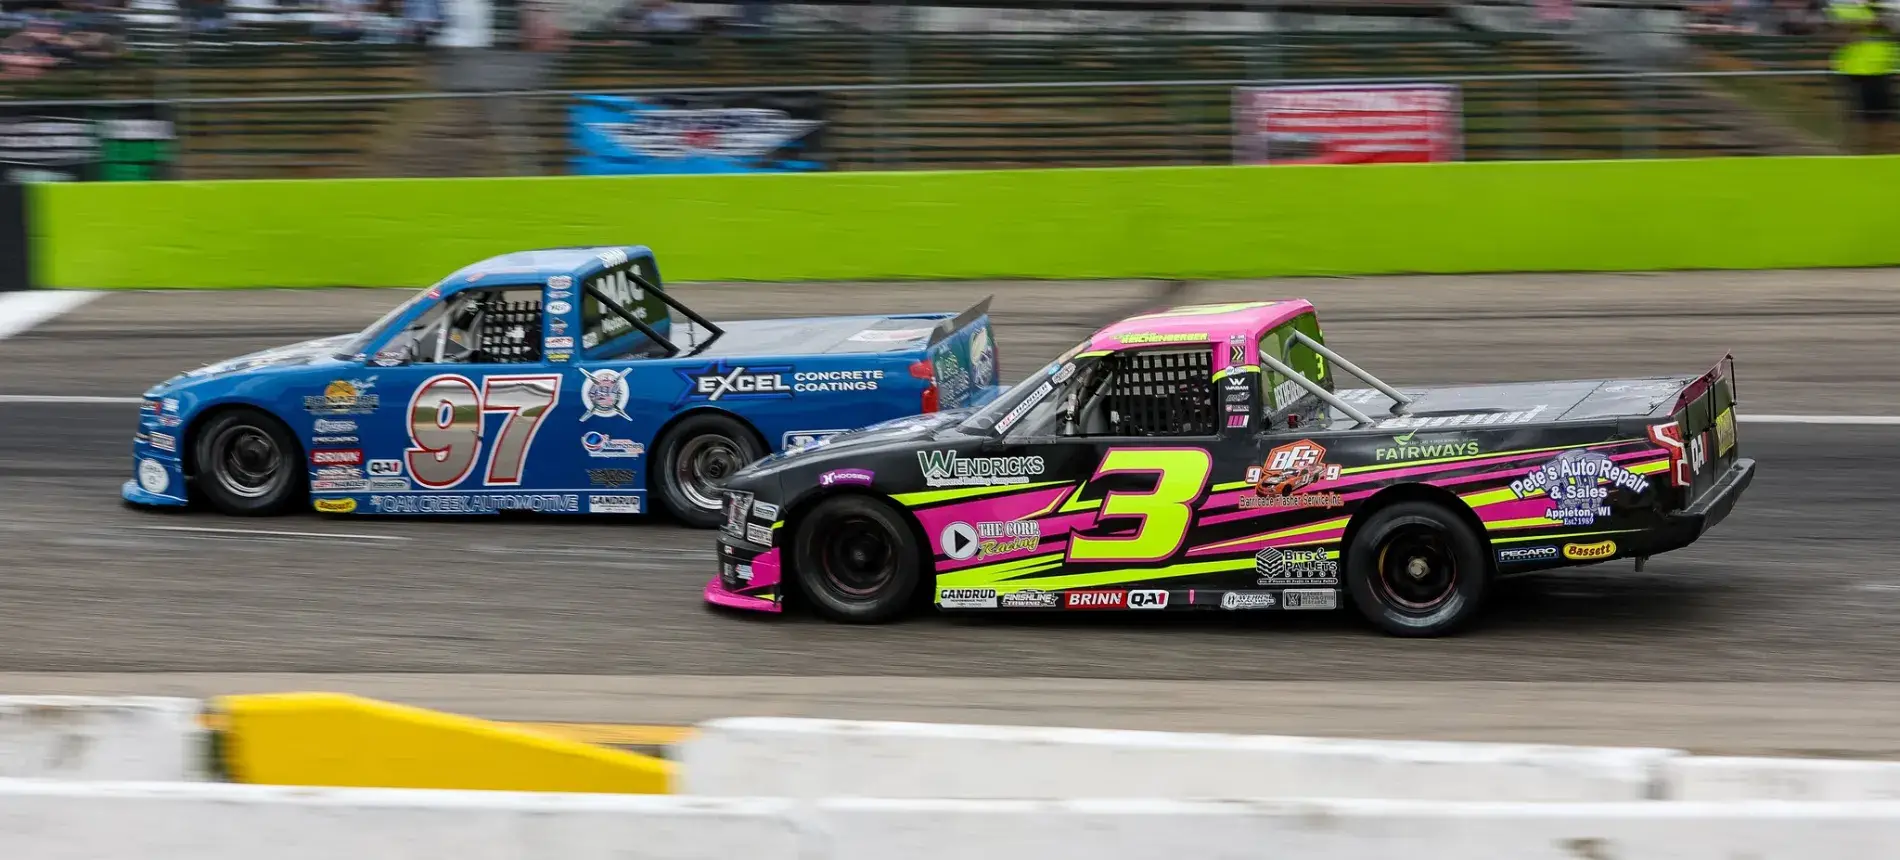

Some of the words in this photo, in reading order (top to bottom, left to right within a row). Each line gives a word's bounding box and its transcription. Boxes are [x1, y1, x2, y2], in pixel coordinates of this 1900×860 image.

[794, 370, 883, 381] CONCRETE
[698, 366, 790, 400] EXCEL
[794, 382, 878, 391] COATINGS
[404, 374, 563, 488] 97
[1376, 442, 1479, 460] FAIRWAYS
[371, 462, 398, 473] QA1
[917, 450, 1045, 478] WENDRICKS
[1510, 466, 1557, 499] Pete's
[1561, 457, 1596, 478] Auto
[1599, 459, 1649, 493] Repair
[1550, 486, 1562, 499] &
[1567, 486, 1607, 498] Sales
[420, 495, 470, 512] CREEK
[471, 494, 579, 512] AUTOMOTIVE
[1066, 447, 1212, 562] 3
[1546, 508, 1594, 519] Appleton,
[1598, 507, 1611, 516] WI
[978, 522, 1003, 537] THE
[1006, 521, 1040, 537] CORP.
[978, 536, 1040, 559] Racing
[1284, 551, 1312, 561] BITS
[1315, 547, 1327, 560] &
[1501, 547, 1557, 557] PECARO
[1569, 544, 1611, 555] Bassett
[1285, 561, 1337, 571] PALLETS
[941, 590, 996, 599] GANDRUD
[1069, 593, 1122, 605] BRINN
[1131, 593, 1165, 606] QA1
